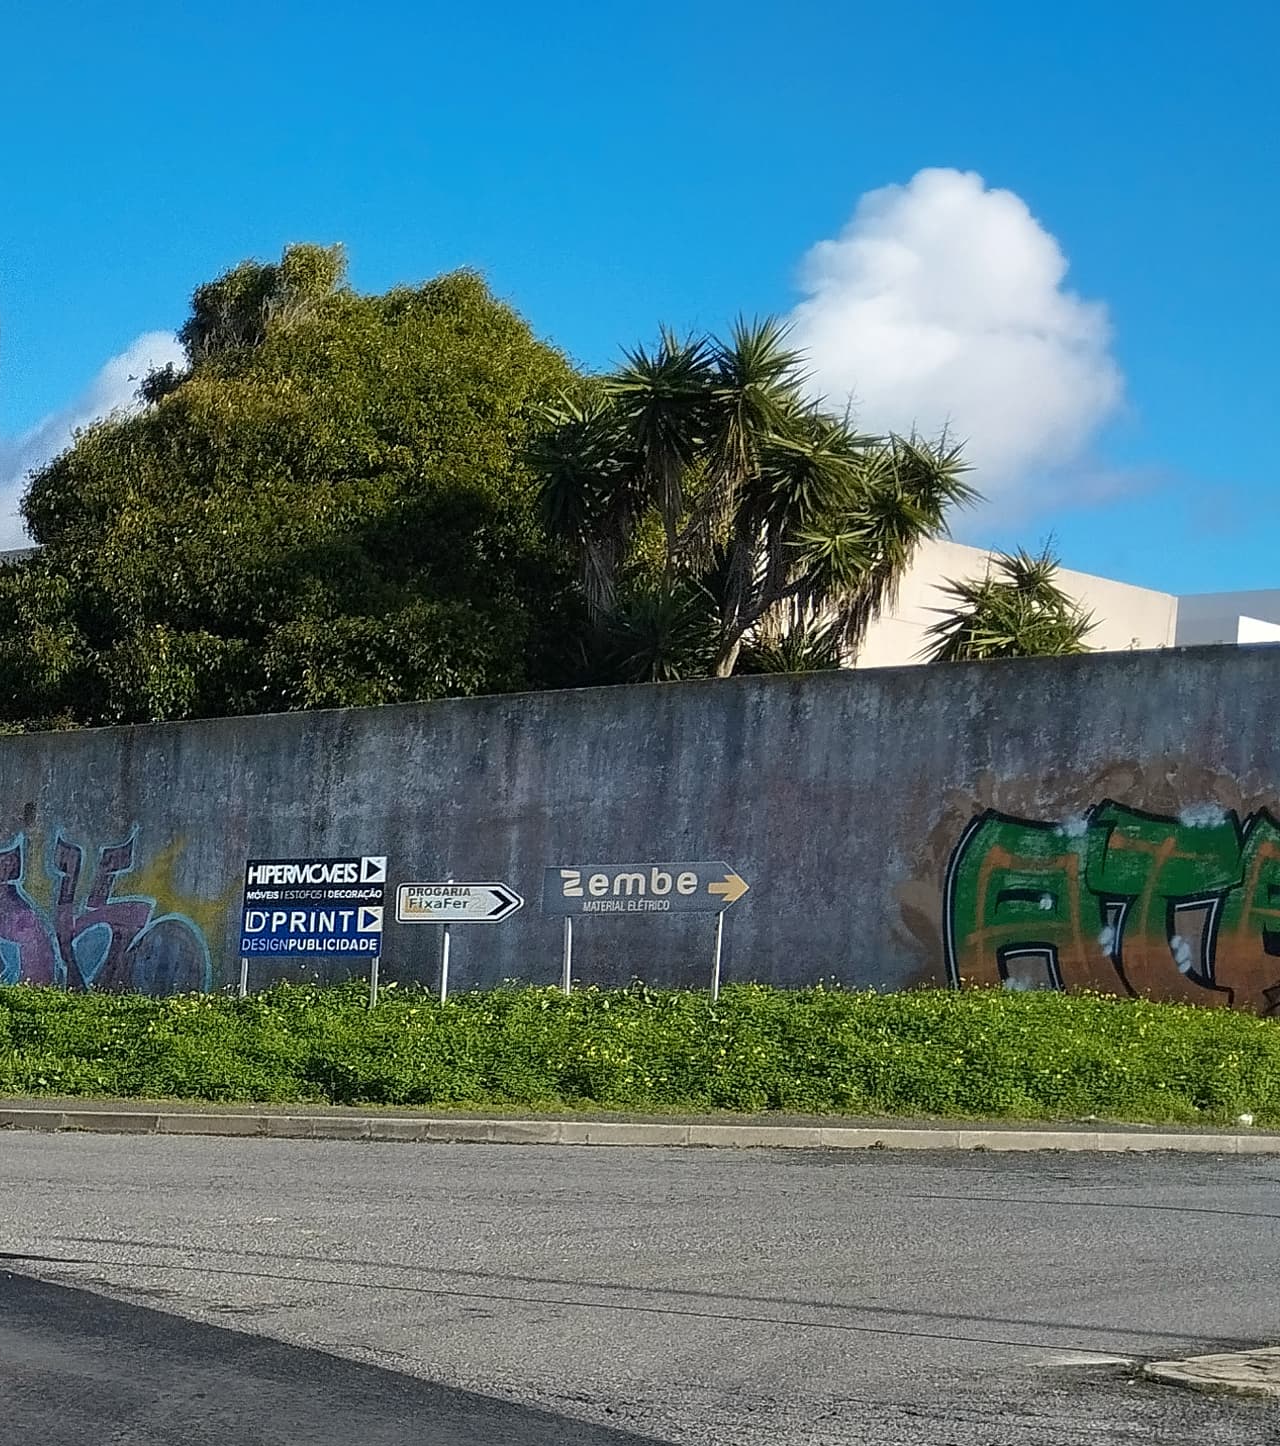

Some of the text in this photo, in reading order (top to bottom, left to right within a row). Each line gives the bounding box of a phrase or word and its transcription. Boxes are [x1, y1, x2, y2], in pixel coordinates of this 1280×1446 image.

[328, 888, 382, 900] DECORAÇÃO
[408, 888, 471, 896] DROGARIA
[409, 898, 469, 909] FixaFer
[583, 899, 670, 912] MATERIAL ELÉTRICO
